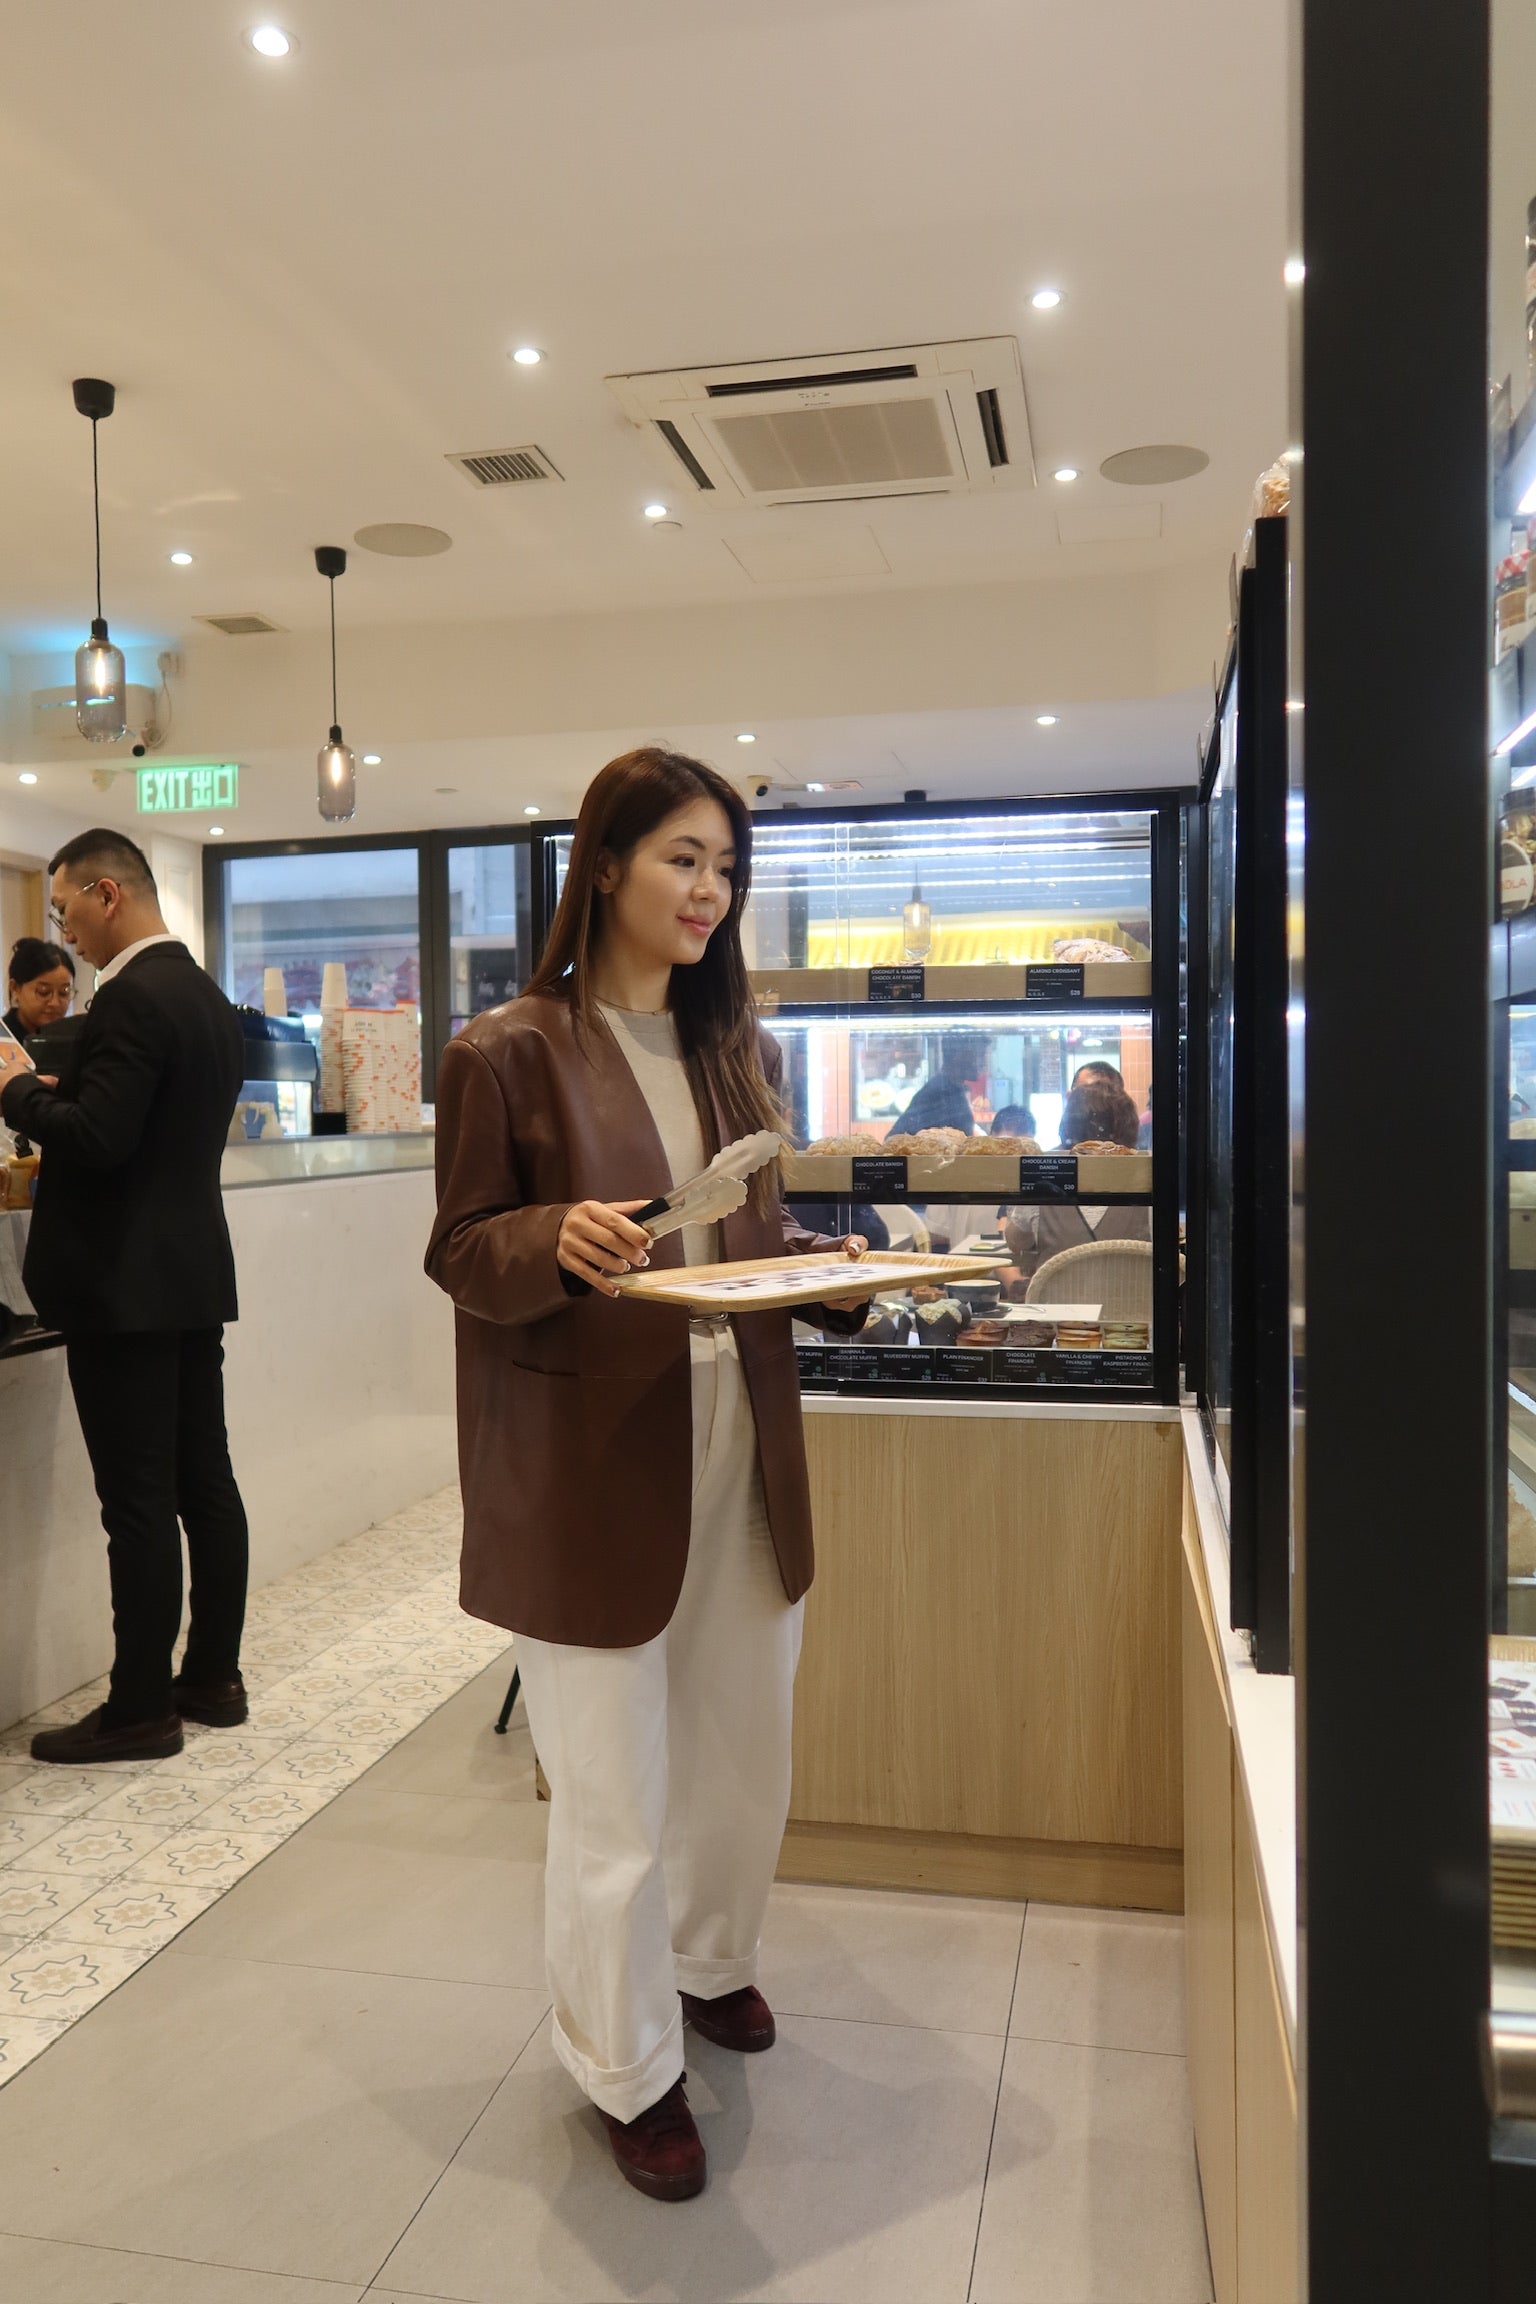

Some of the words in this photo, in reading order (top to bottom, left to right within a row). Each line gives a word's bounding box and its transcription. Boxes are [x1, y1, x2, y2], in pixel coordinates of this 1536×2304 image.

[141, 770, 189, 810] EXIT
[192, 768, 233, 808] 出口
[1502, 878, 1528, 890] OLA
